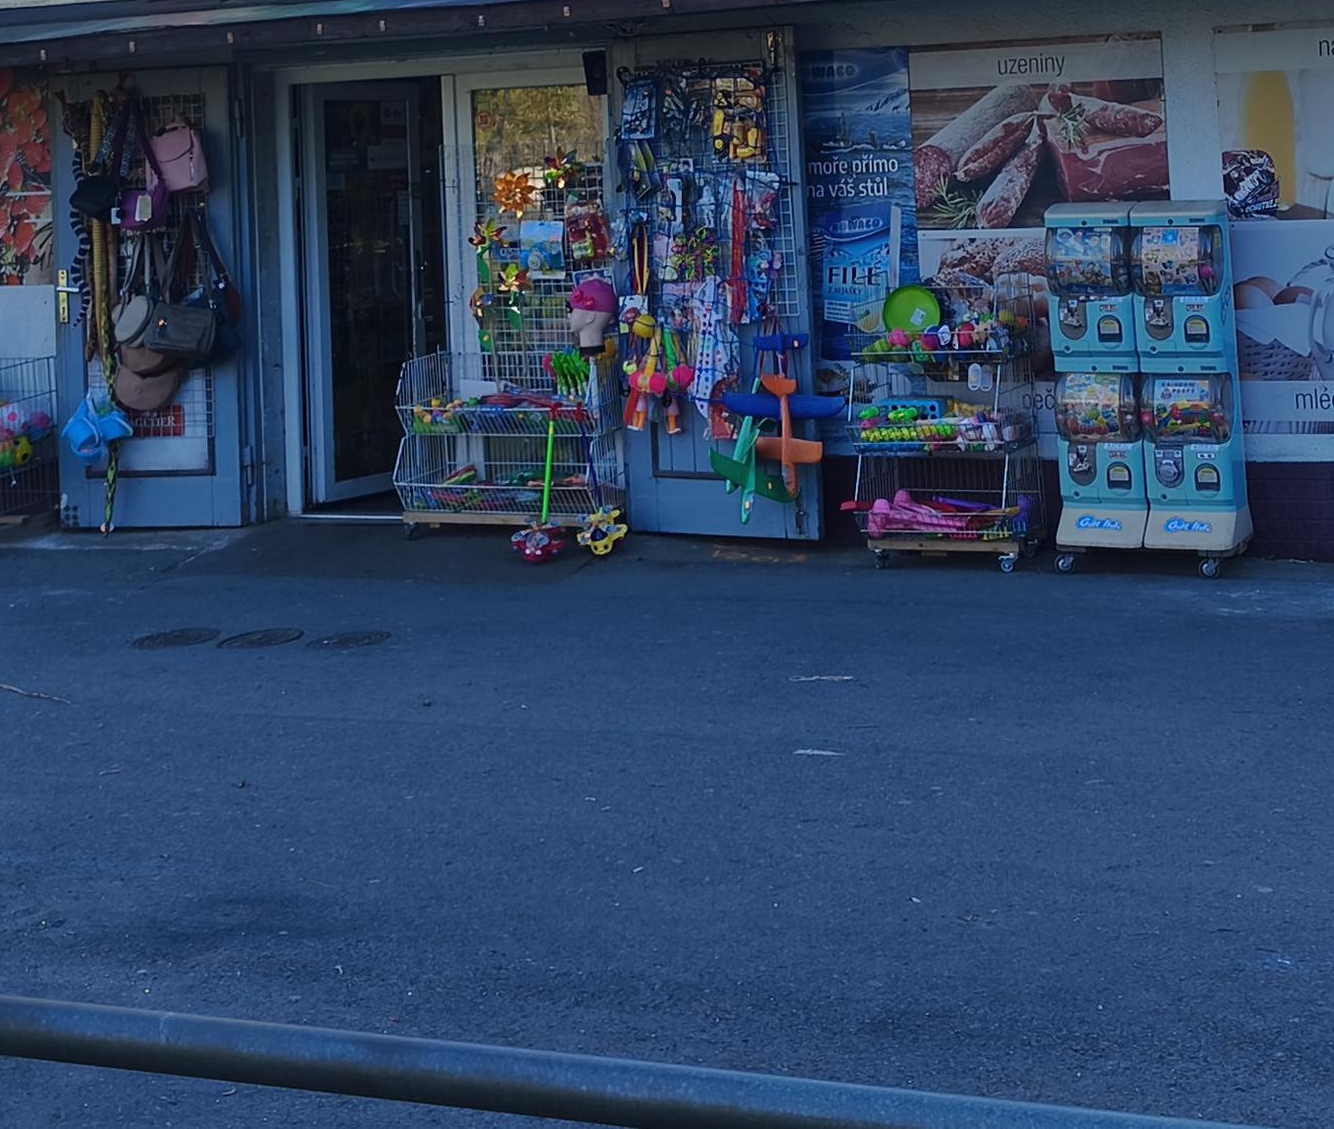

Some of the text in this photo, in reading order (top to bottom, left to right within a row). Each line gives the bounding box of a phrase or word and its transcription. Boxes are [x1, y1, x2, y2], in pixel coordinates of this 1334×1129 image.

[997, 52, 1065, 76] uzeniny
[809, 155, 898, 179] moře přímo
[829, 179, 855, 198] váš
[859, 176, 888, 197] stůl
[1022, 388, 1055, 416] peč
